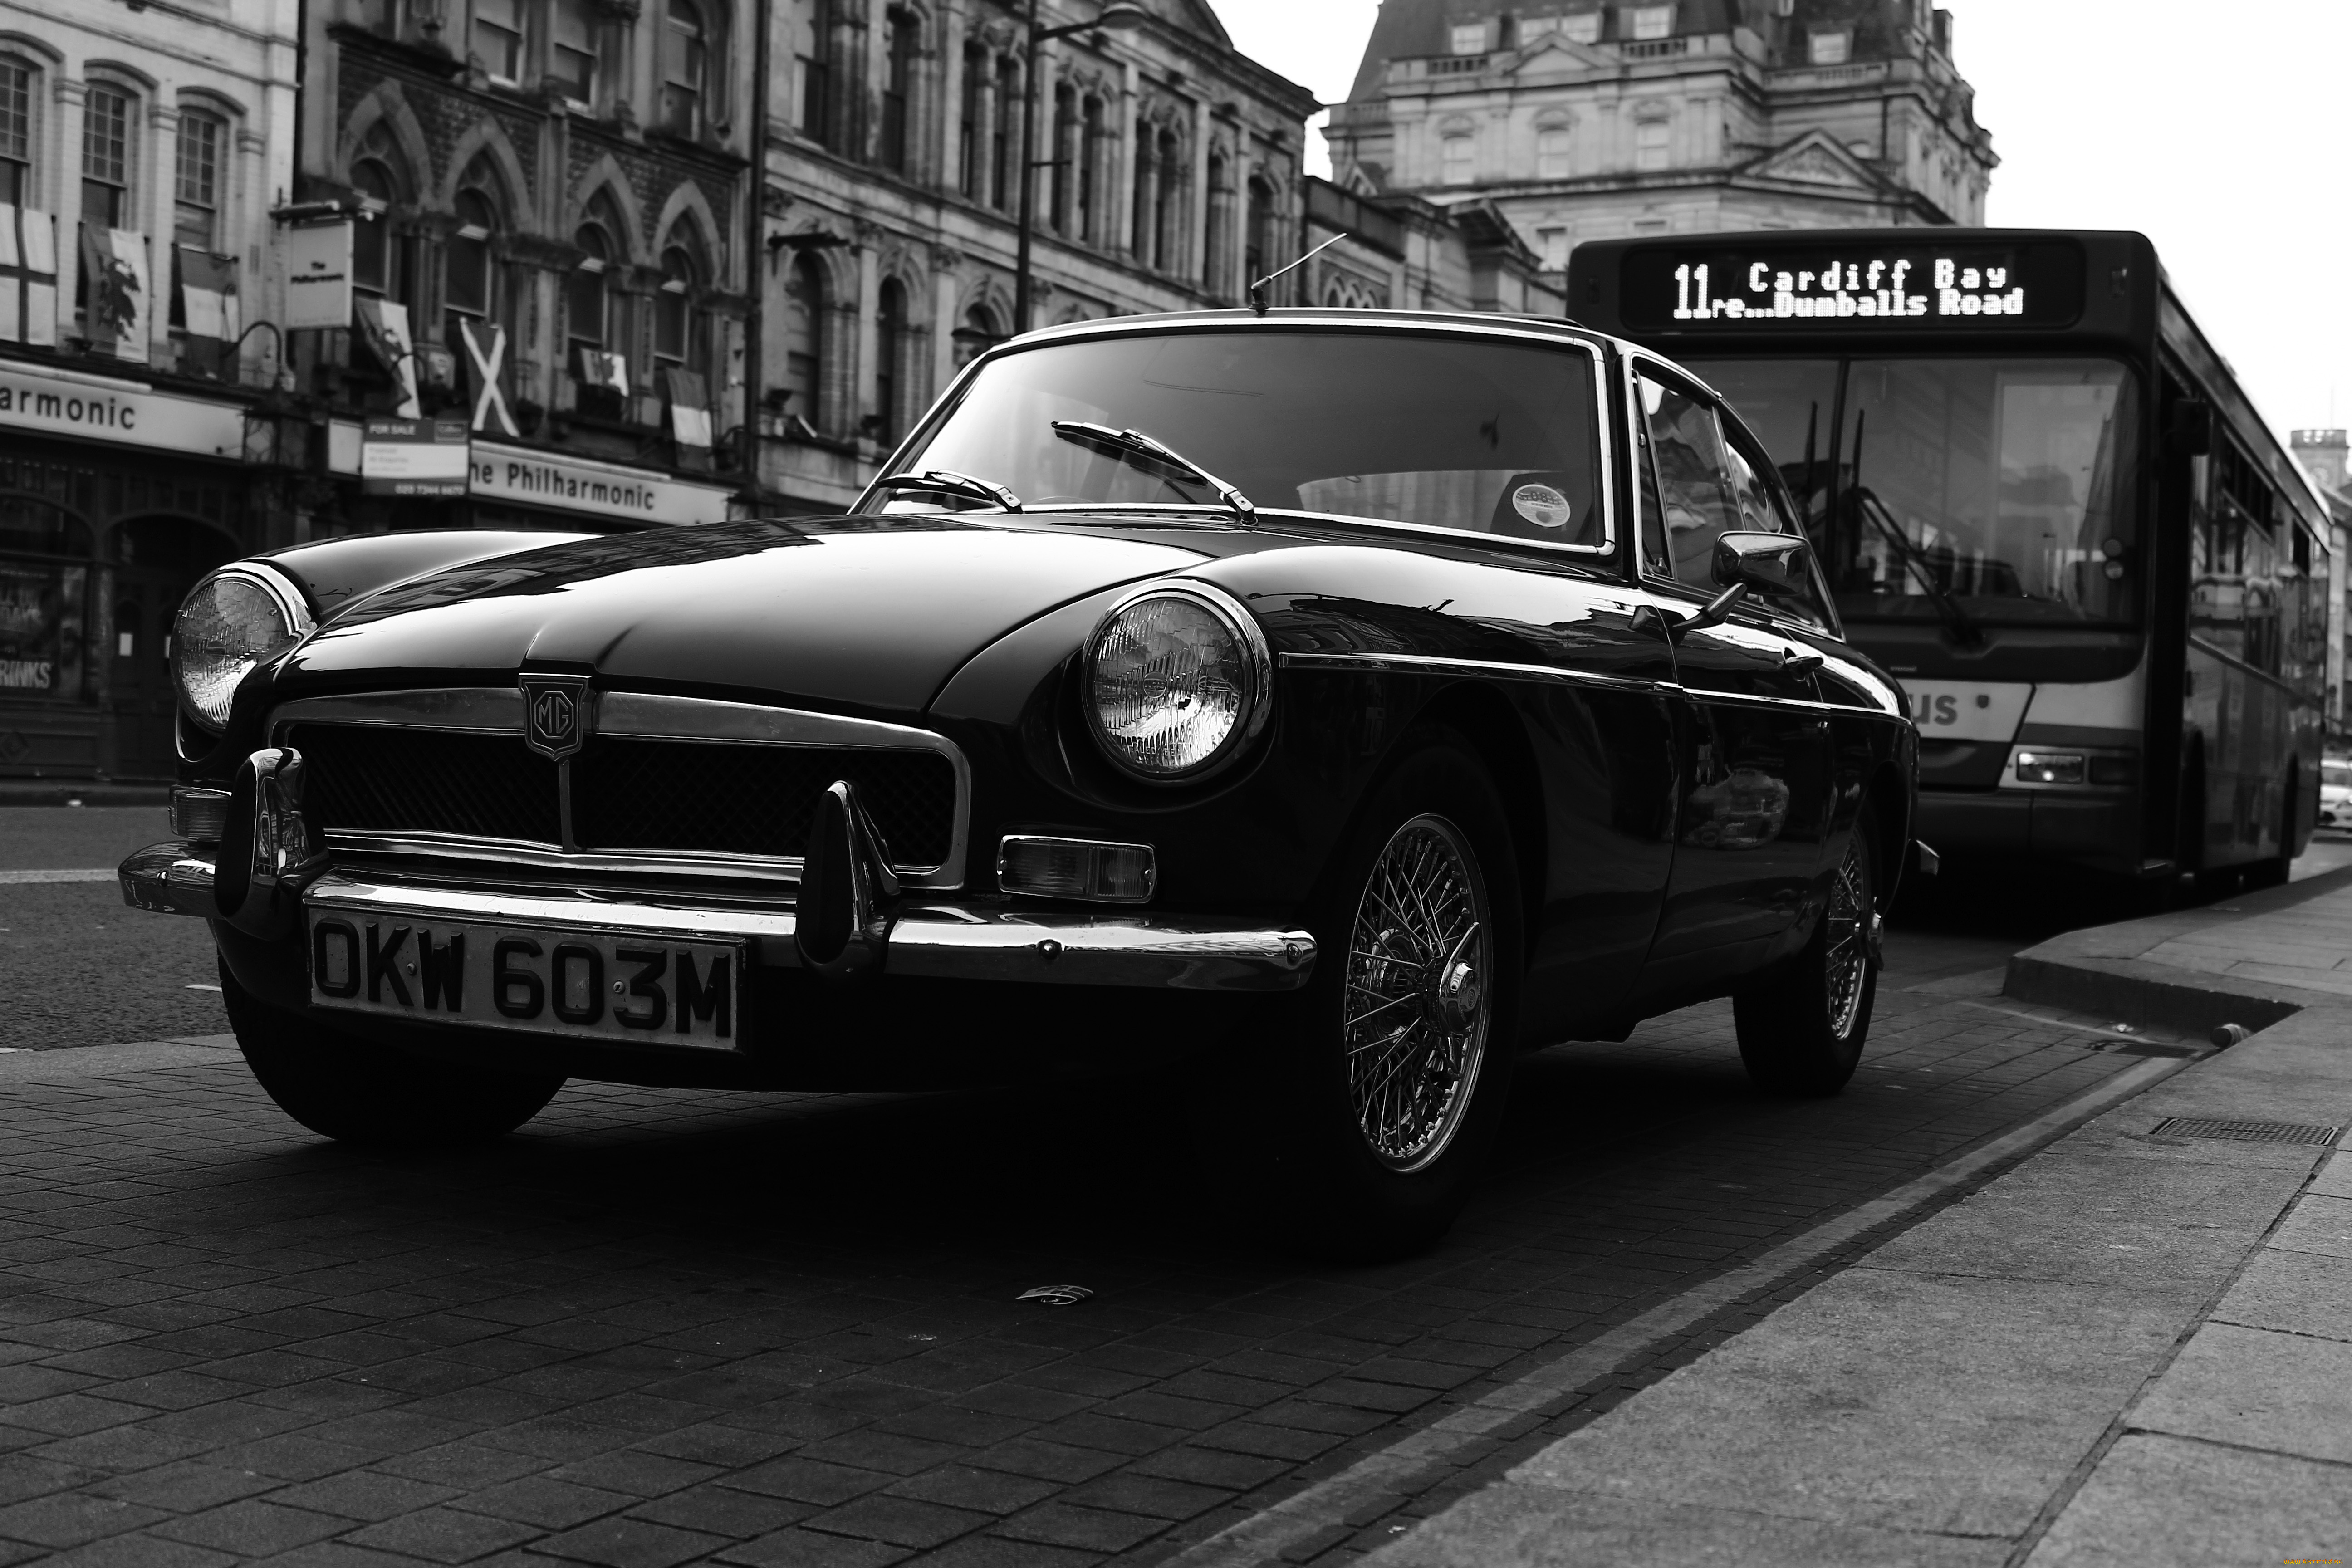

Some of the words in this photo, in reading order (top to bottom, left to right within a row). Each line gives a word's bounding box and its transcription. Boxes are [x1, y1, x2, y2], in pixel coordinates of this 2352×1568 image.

[1673, 263, 1712, 319] 11
[1749, 259, 1911, 292] Cardiff
[1934, 258, 2006, 289] Bay
[1939, 288, 2024, 316] Road
[0, 387, 135, 430] armonic
[369, 424, 389, 435] FOR
[391, 425, 415, 436] SALE
[507, 463, 655, 510] Philharmonic
[539, 696, 569, 734] MG
[314, 918, 464, 1013] OKW
[493, 936, 731, 1037] 603M
